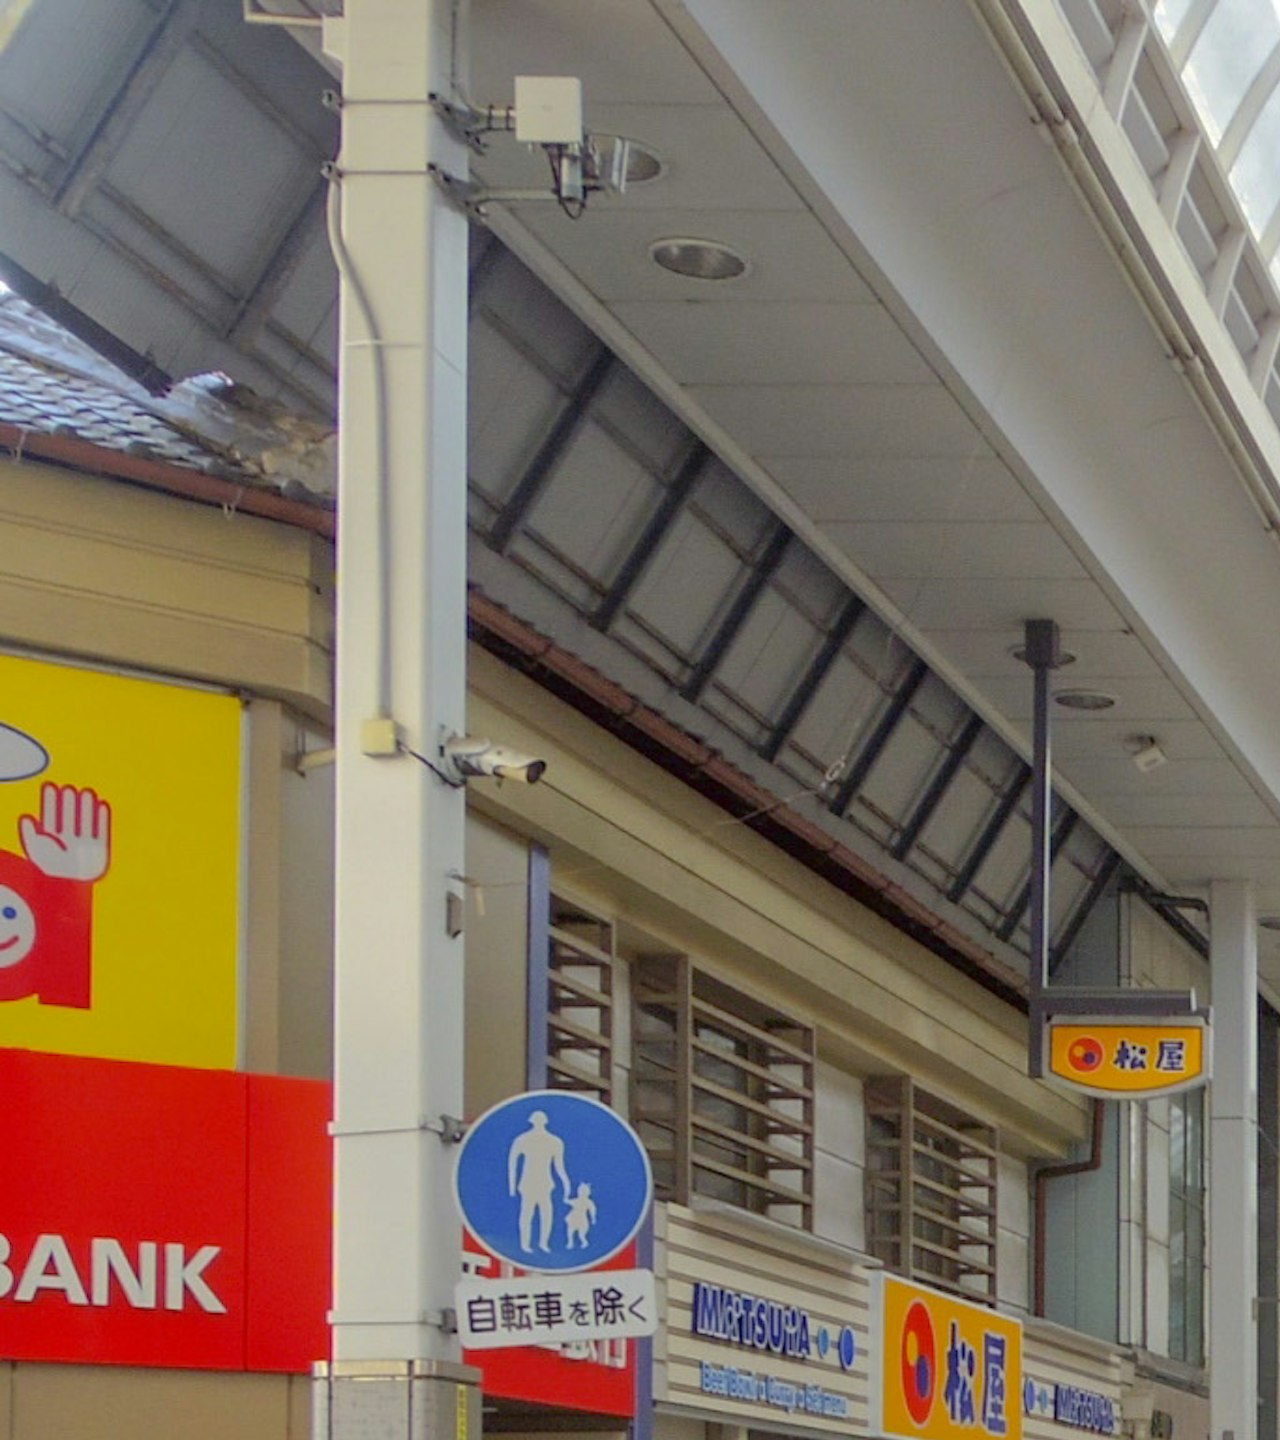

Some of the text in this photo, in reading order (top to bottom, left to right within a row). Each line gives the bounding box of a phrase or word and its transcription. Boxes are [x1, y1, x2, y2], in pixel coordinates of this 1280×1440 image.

[1113, 1040, 1186, 1070] 松屋
[0, 1232, 228, 1314] ANK
[467, 1286, 648, 1333] 自転車を除く
[943, 1320, 1007, 1434] 松屋
